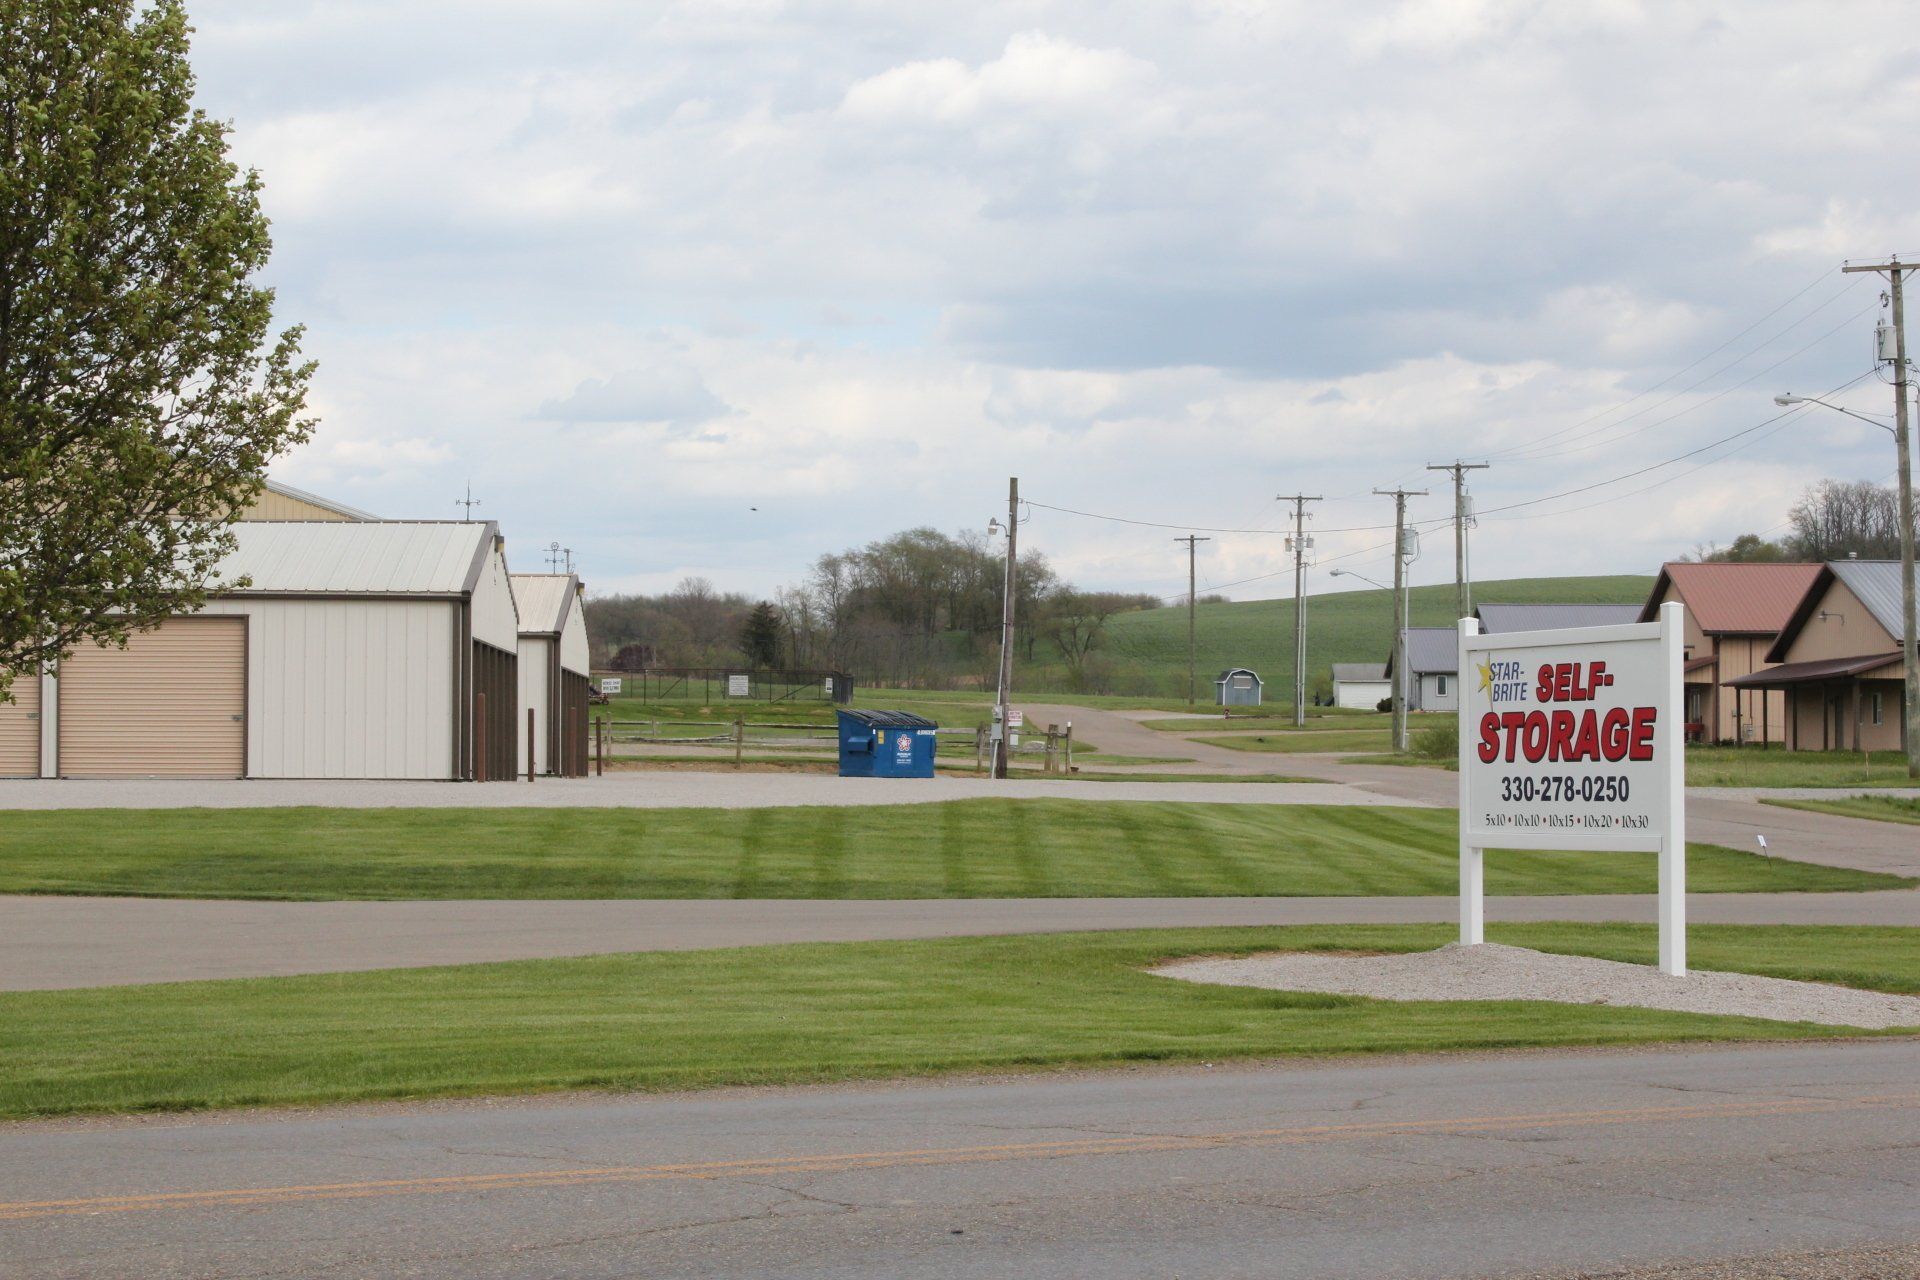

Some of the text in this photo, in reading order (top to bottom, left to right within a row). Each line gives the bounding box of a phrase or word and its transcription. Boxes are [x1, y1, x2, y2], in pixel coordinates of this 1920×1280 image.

[1489, 661, 1525, 681] STAR-
[1536, 661, 1614, 703] SELF-
[1492, 682, 1528, 702] BRITE
[1477, 707, 1658, 764] STORAGE
[1501, 776, 1630, 802] 330-278-0250
[1485, 814, 1649, 829] 5x10 10x10 10x15 10x20 10x30
